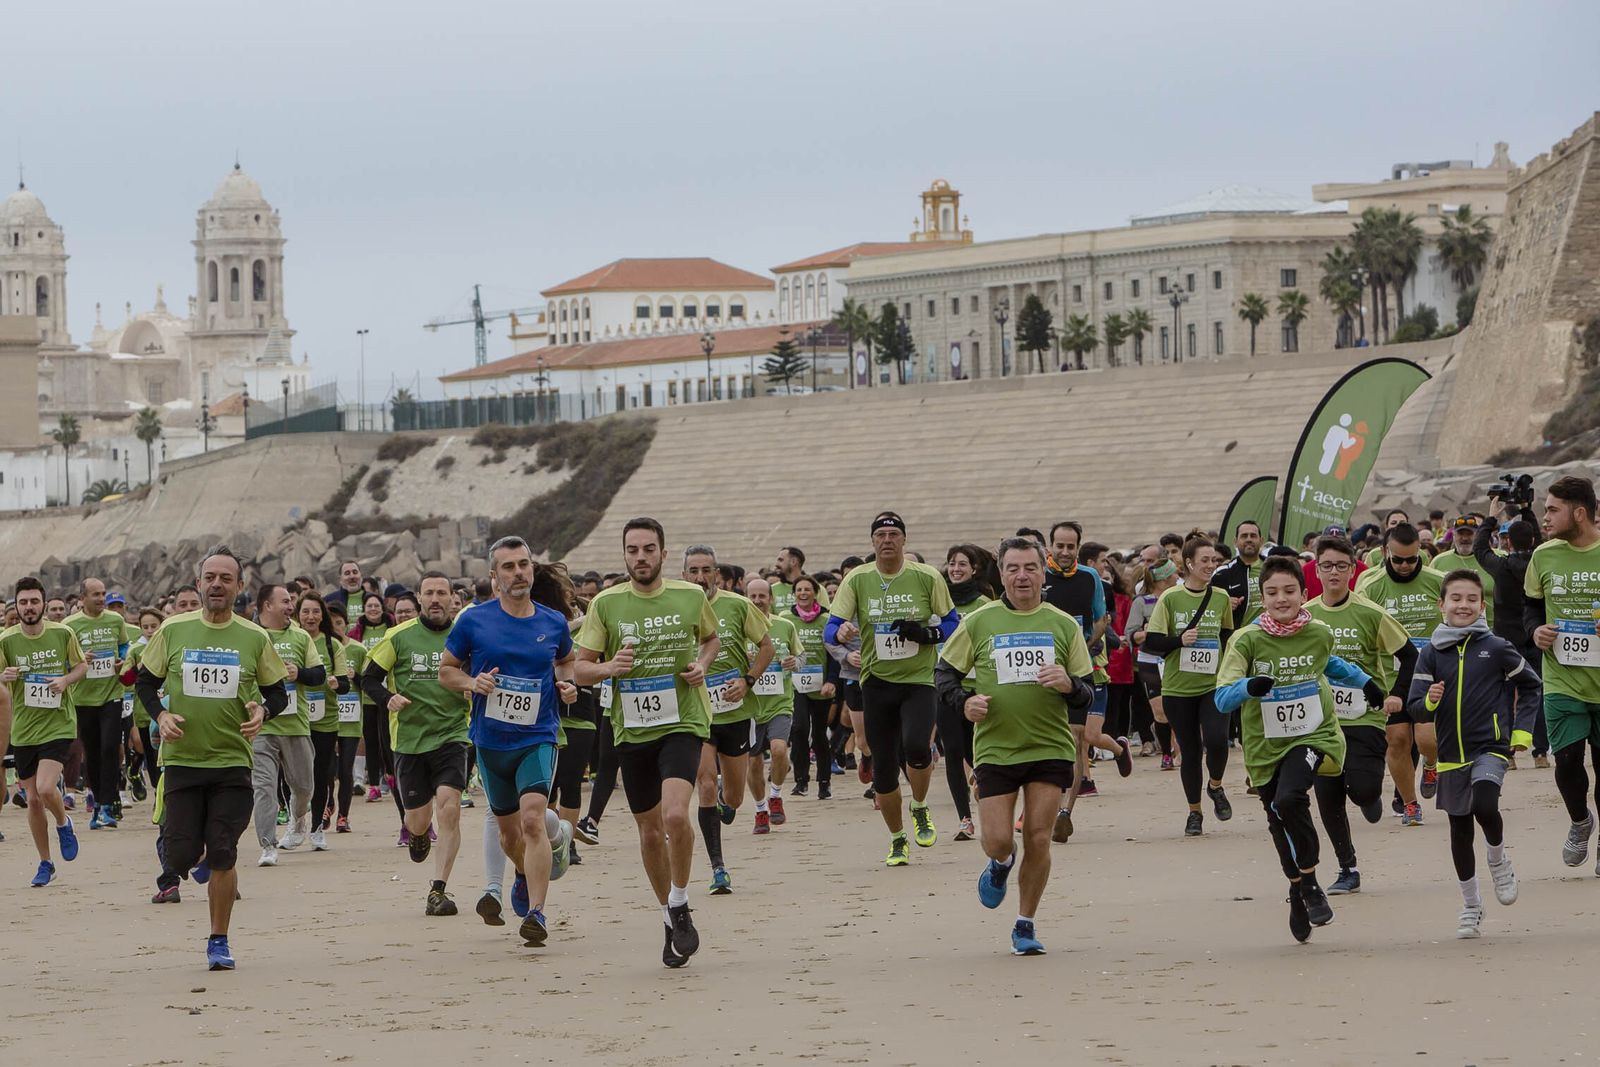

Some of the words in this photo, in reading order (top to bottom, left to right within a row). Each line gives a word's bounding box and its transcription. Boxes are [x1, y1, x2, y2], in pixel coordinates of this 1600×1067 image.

[1313, 490, 1352, 511] aecc
[886, 594, 914, 603] aecc
[1401, 593, 1428, 603] aecc
[644, 614, 681, 628] aecc
[93, 627, 112, 636] aecc
[658, 630, 688, 641] marcha
[799, 628, 820, 636] aecc
[1563, 636, 1589, 653] 859
[32, 648, 58, 661] aecc
[1005, 650, 1045, 667] 1998
[1190, 650, 1211, 664] 820
[1279, 654, 1315, 668] aecc
[91, 659, 112, 671] 1216
[192, 666, 229, 684] 1613
[758, 674, 777, 686] 893
[800, 675, 812, 685] 62
[339, 702, 356, 713] 257
[496, 692, 532, 712] 1788
[633, 695, 662, 713] 143
[1276, 702, 1306, 722] 673
[1290, 723, 1308, 732] aecc
